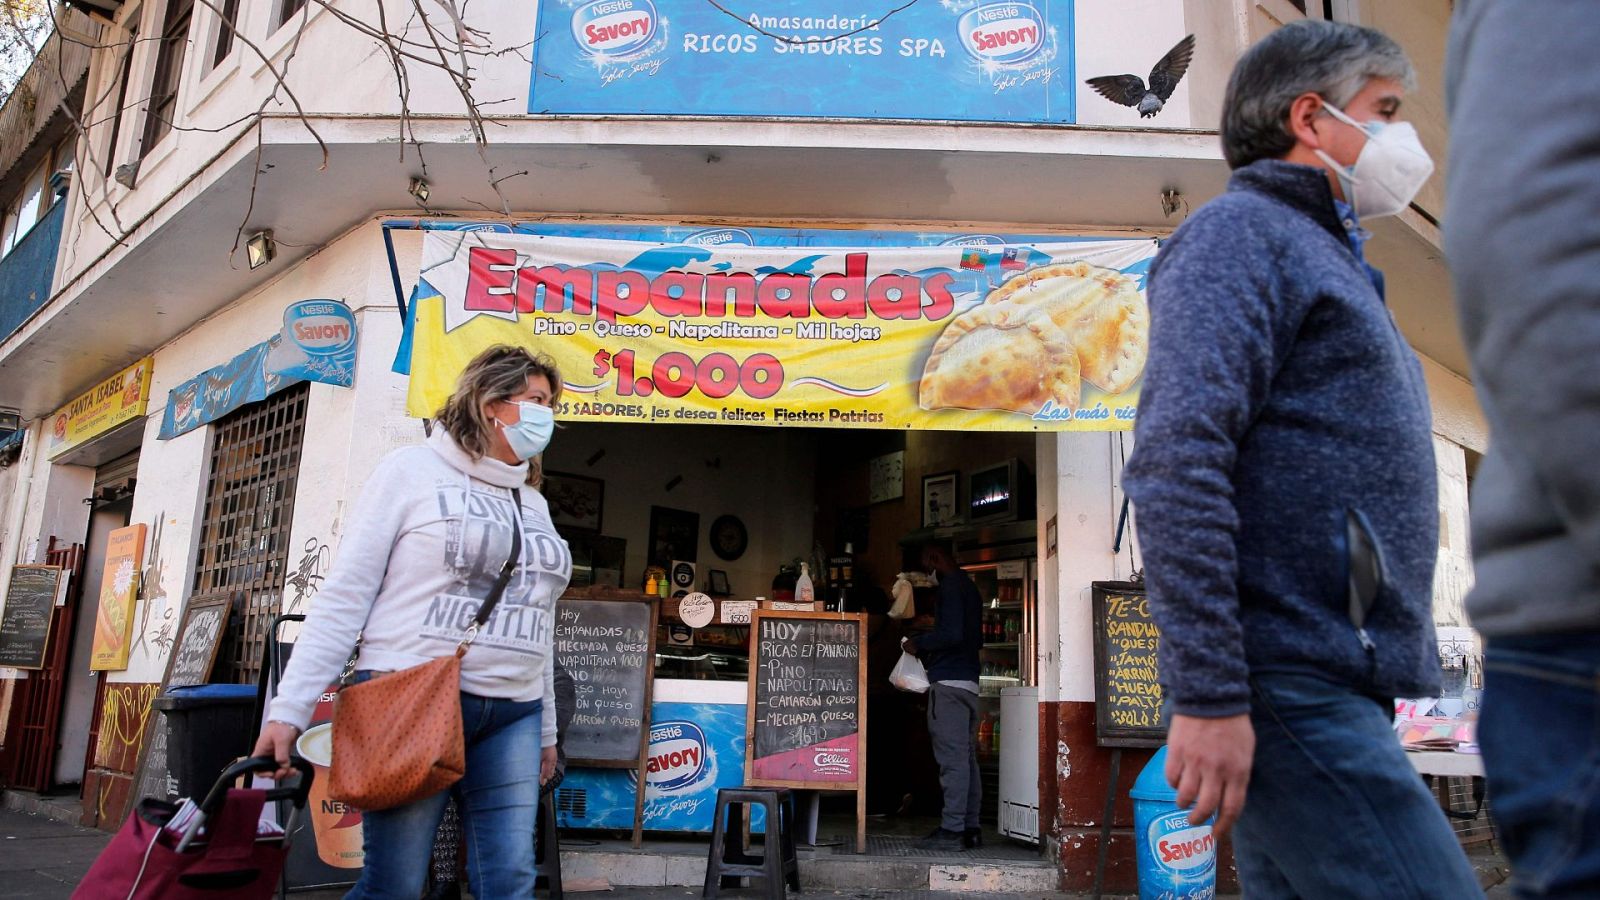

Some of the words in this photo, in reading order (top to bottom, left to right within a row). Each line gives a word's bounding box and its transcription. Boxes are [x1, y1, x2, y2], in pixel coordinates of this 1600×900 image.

[585, 17, 649, 45] Savory
[748, 13, 879, 31] Amasandería
[683, 33, 758, 54] RICOS
[774, 35, 883, 56] SABORES
[899, 38, 946, 58] SPA
[972, 26, 1037, 51] Savory
[464, 246, 955, 326] Empanadas
[294, 321, 350, 341] Savory
[534, 317, 576, 336] Pino
[594, 319, 652, 338] Queso
[668, 320, 779, 342] Napolitana
[795, 322, 826, 340] Mil
[830, 323, 882, 343] hojas
[593, 348, 785, 400] $1.000
[69, 393, 93, 420] SANTA
[95, 374, 124, 404] ISABEL
[553, 401, 569, 416] OS
[673, 406, 718, 420] desea
[720, 407, 766, 421] felices
[773, 407, 825, 422] Fiestas
[828, 408, 884, 423] Patrias
[1032, 400, 1071, 420] Las
[1074, 402, 1109, 420] más
[1114, 405, 1137, 419] ric
[555, 625, 624, 640] EMPANADAS
[763, 621, 803, 641] HOY
[615, 641, 649, 653] QUESO
[594, 699, 633, 713] QUESO
[826, 695, 857, 706] QUESO
[610, 715, 640, 727] QUESO
[821, 710, 855, 723] QUESO
[646, 747, 699, 775] avory
[1165, 817, 1190, 831] Nes
